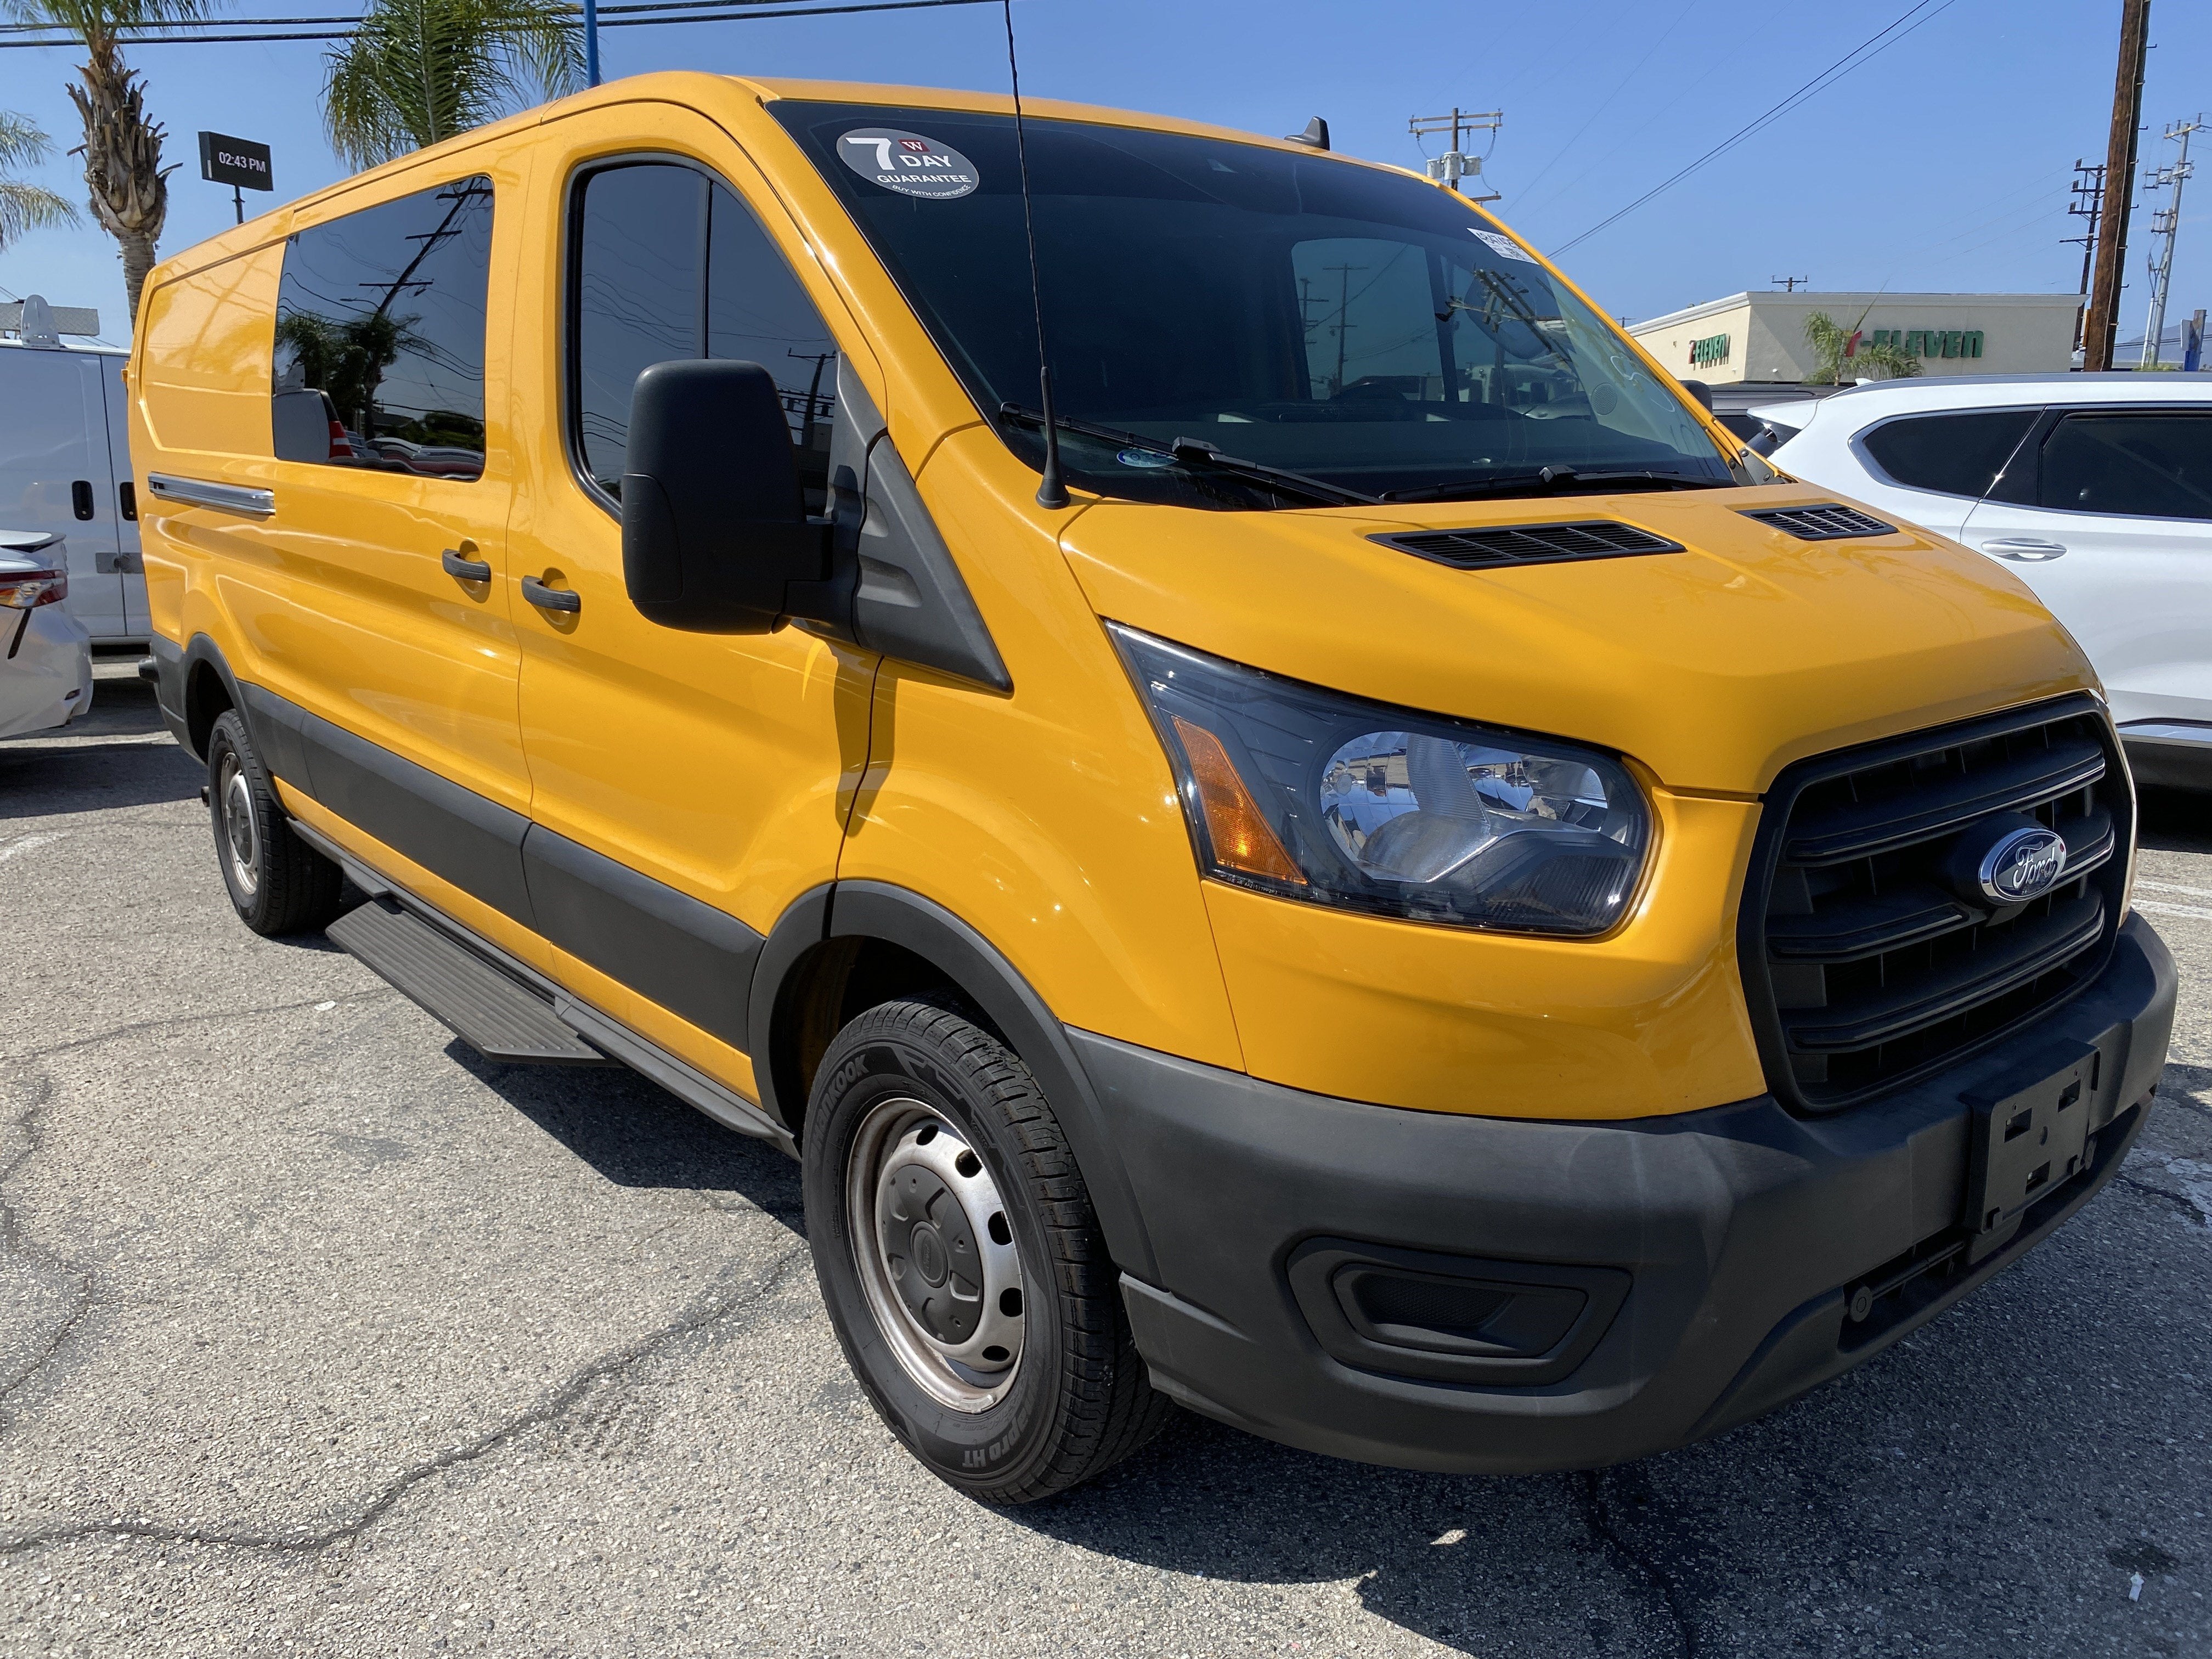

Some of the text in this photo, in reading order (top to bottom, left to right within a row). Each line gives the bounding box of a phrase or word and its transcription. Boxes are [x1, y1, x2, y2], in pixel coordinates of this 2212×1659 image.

[219, 151, 266, 173] 02:43 PM
[845, 137, 952, 170] 7 DAY
[876, 174, 972, 183] GUARANTEE
[892, 184, 910, 193] BUY
[932, 184, 972, 198] CONFIDENCE
[2012, 840, 2058, 889] Ford
[962, 1448, 987, 1468] HT
